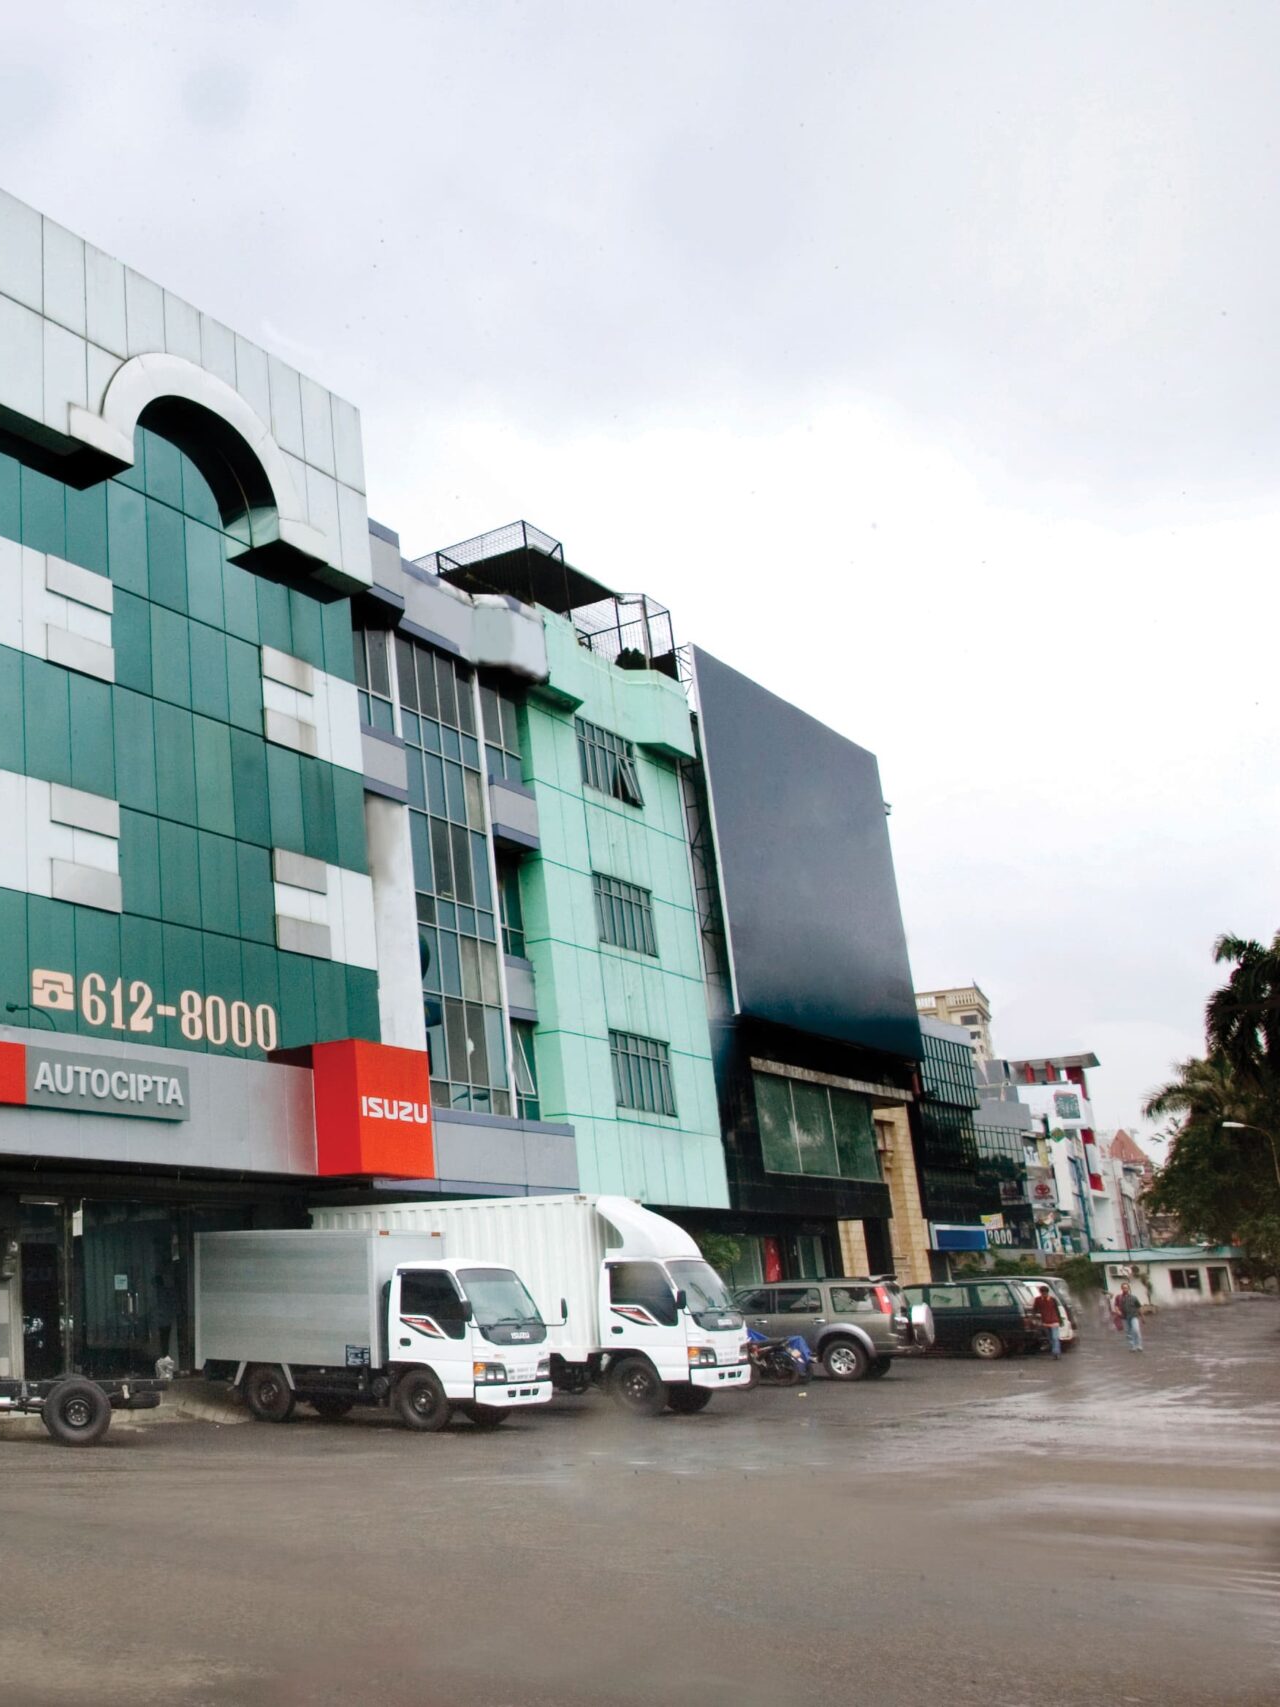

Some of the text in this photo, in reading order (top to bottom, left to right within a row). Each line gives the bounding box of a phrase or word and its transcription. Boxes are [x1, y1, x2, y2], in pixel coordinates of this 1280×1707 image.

[81, 972, 278, 1051] 612-8000
[33, 1061, 185, 1107] AUTOCIPTA
[361, 1095, 428, 1124] ISUZU
